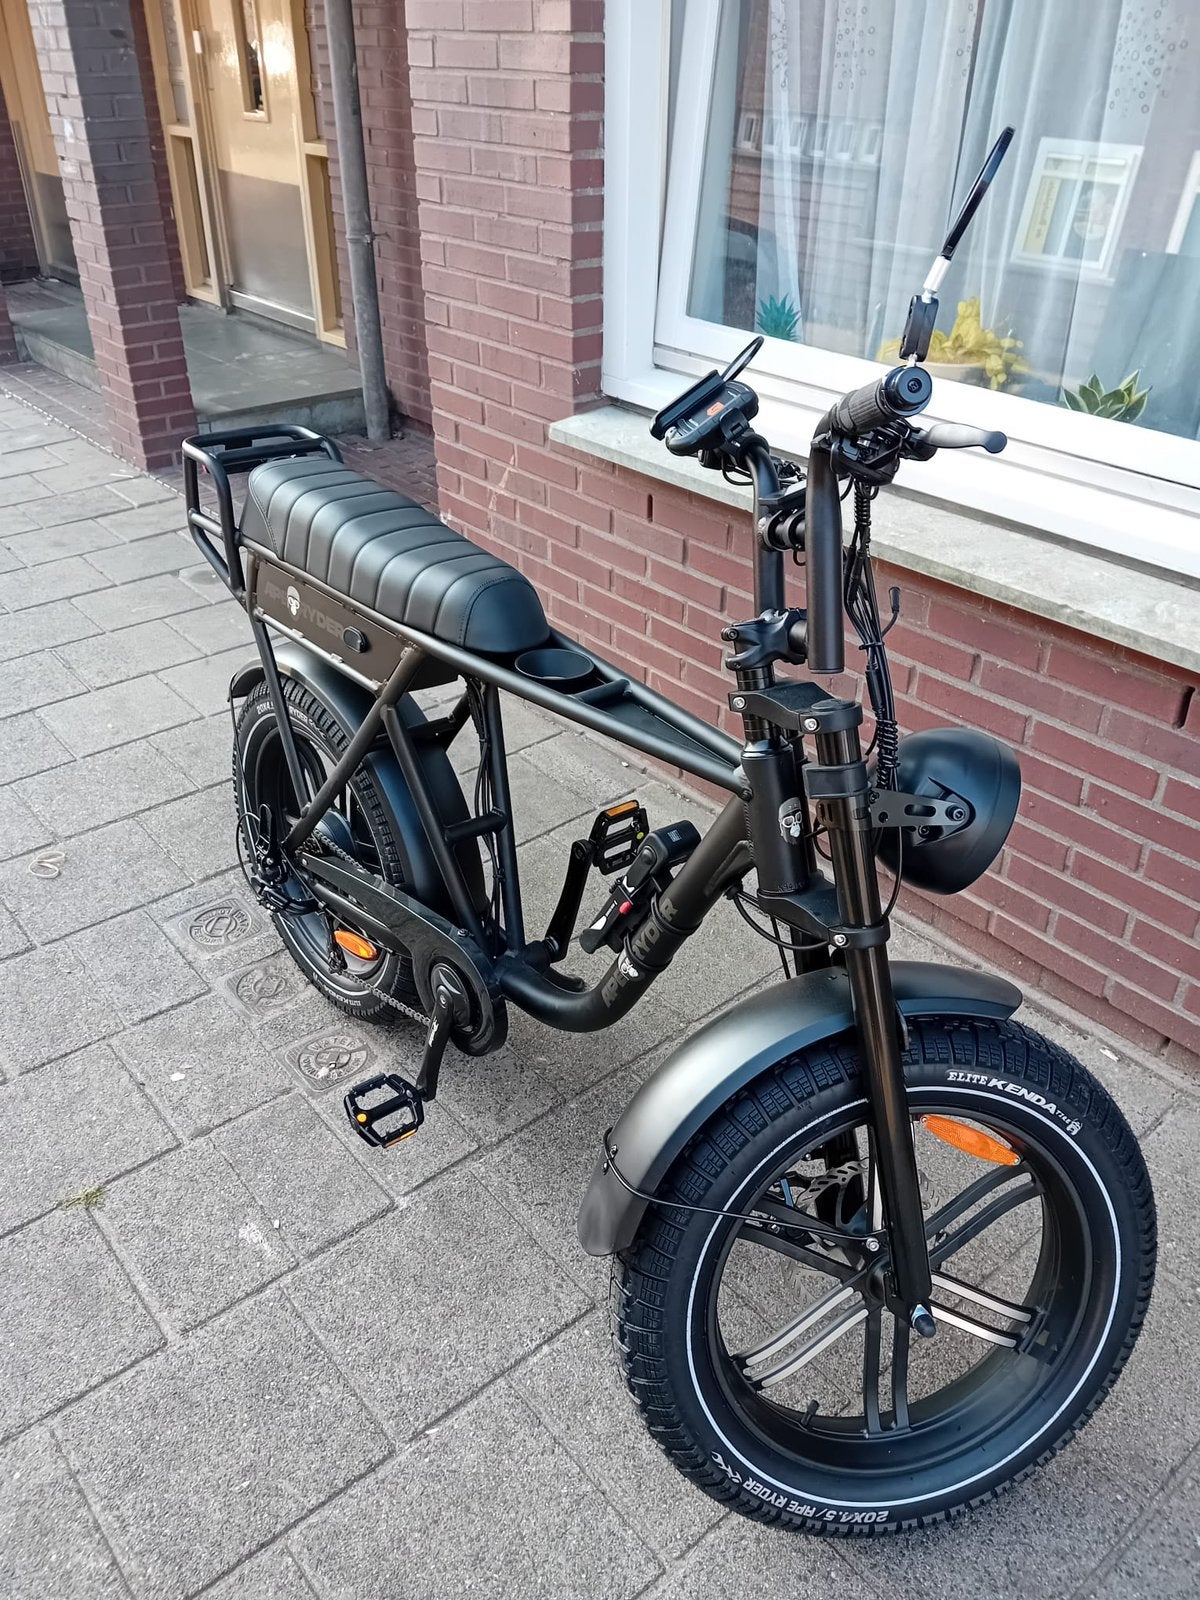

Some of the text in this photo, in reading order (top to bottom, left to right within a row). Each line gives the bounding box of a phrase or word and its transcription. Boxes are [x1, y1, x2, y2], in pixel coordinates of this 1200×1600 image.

[308, 1036, 360, 1051] WATER
[947, 1072, 988, 1085] ELITE
[987, 1078, 1057, 1115] KENDA
[743, 1476, 788, 1508] RYDER
[786, 1500, 817, 1518] APE
